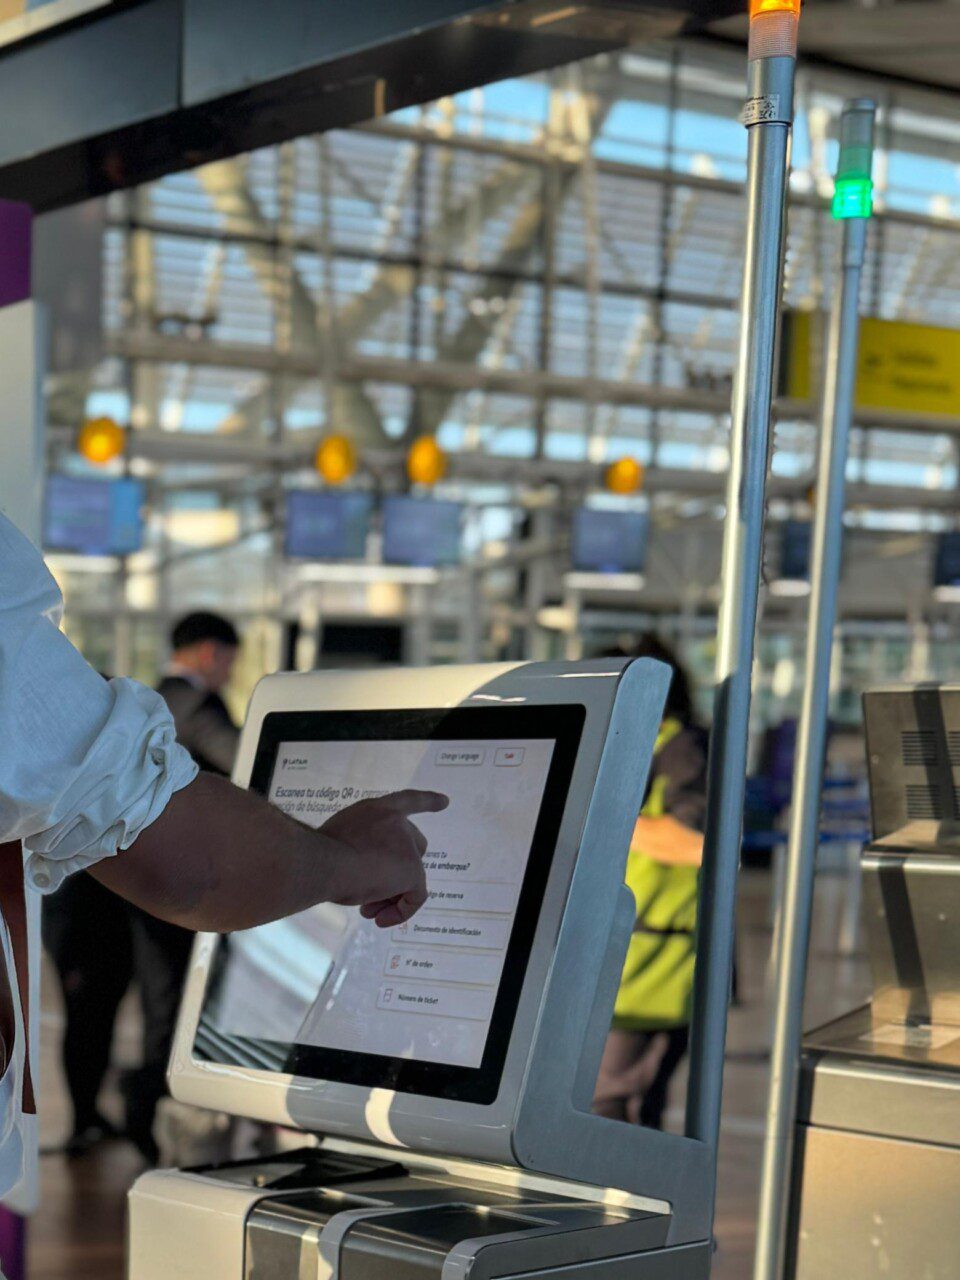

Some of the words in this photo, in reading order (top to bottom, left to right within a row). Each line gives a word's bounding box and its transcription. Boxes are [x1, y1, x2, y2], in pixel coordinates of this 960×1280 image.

[275, 786, 305, 798] Escanea
[306, 788, 315, 798] tu
[315, 786, 340, 801] código
[341, 787, 354, 799] QR
[438, 862, 471, 872] embarque?
[414, 924, 441, 933] Documento
[448, 926, 482, 936] identificación
